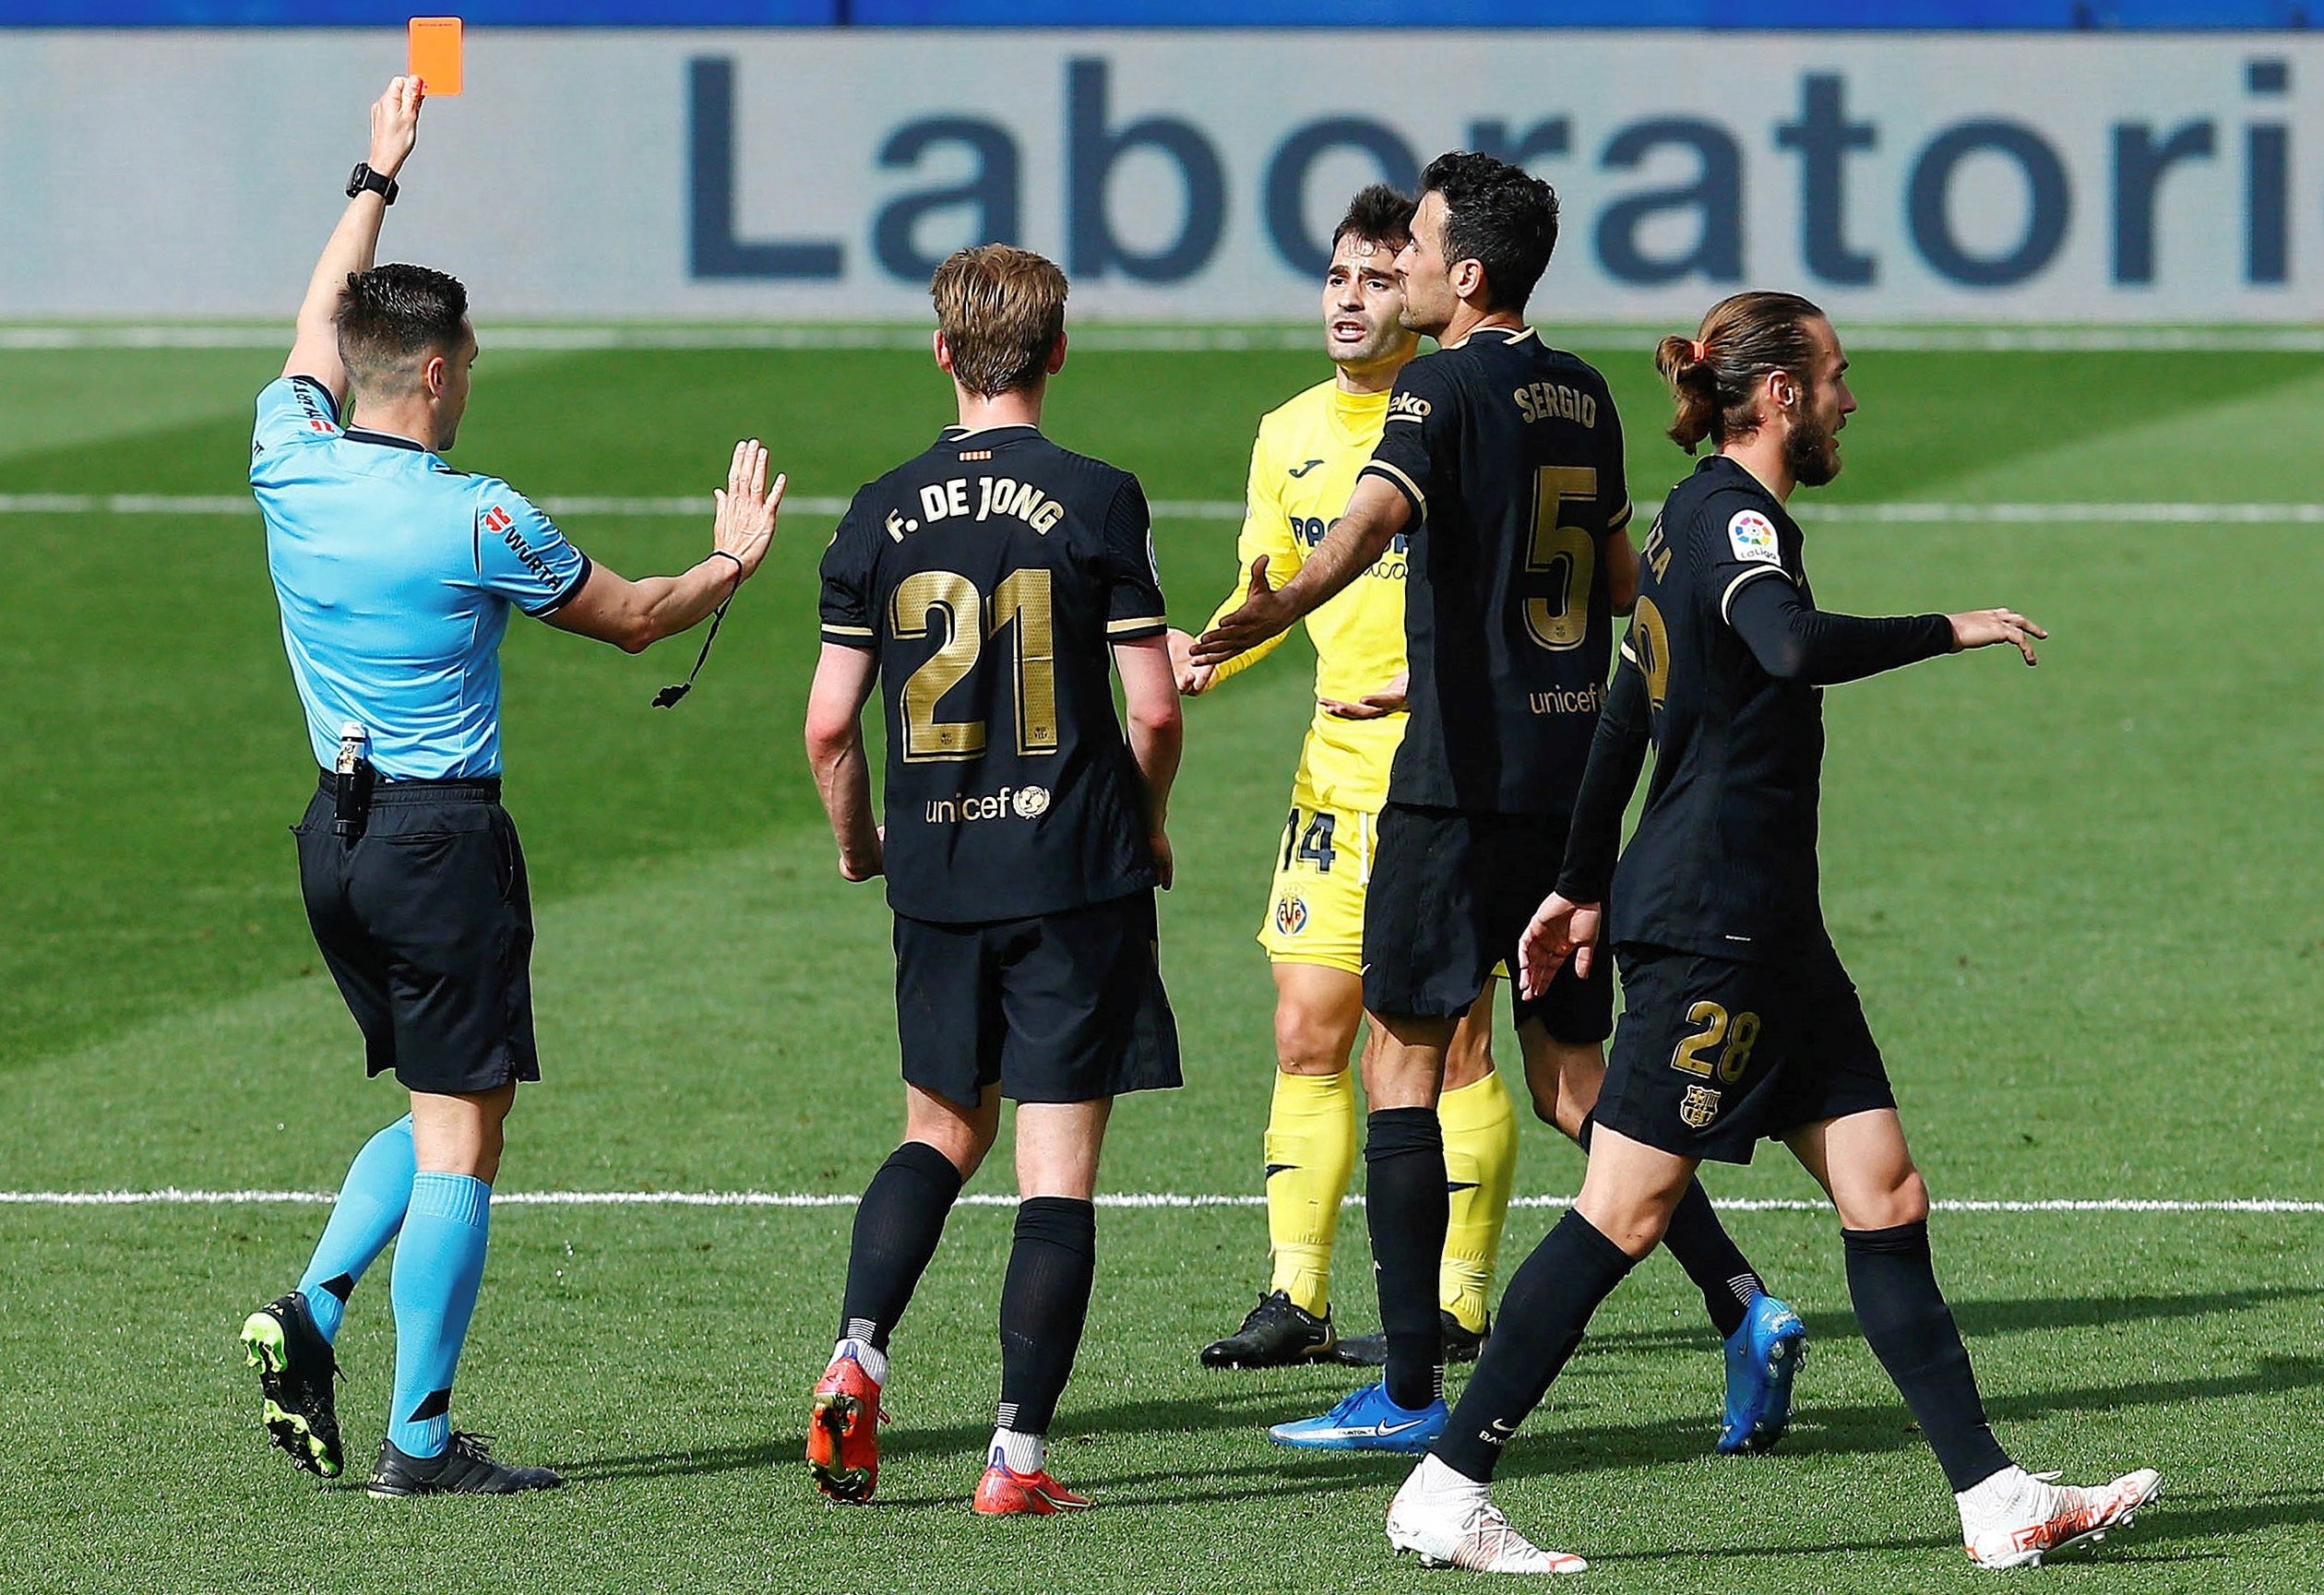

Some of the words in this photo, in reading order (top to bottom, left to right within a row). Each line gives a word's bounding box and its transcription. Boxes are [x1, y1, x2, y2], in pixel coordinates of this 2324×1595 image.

[1388, 391, 1432, 417] eko
[1513, 381, 1597, 429] SERGIO
[884, 506, 919, 543] F.
[920, 477, 970, 523] DE
[975, 476, 1066, 535] JONG
[504, 525, 564, 592] WÜRTH
[1523, 465, 1598, 651] 5
[888, 568, 1058, 764] 21
[1530, 682, 1597, 714] unicef
[925, 786, 1011, 824] unicef
[1283, 808, 1336, 873] 14
[1670, 1000, 1761, 1085] 28
